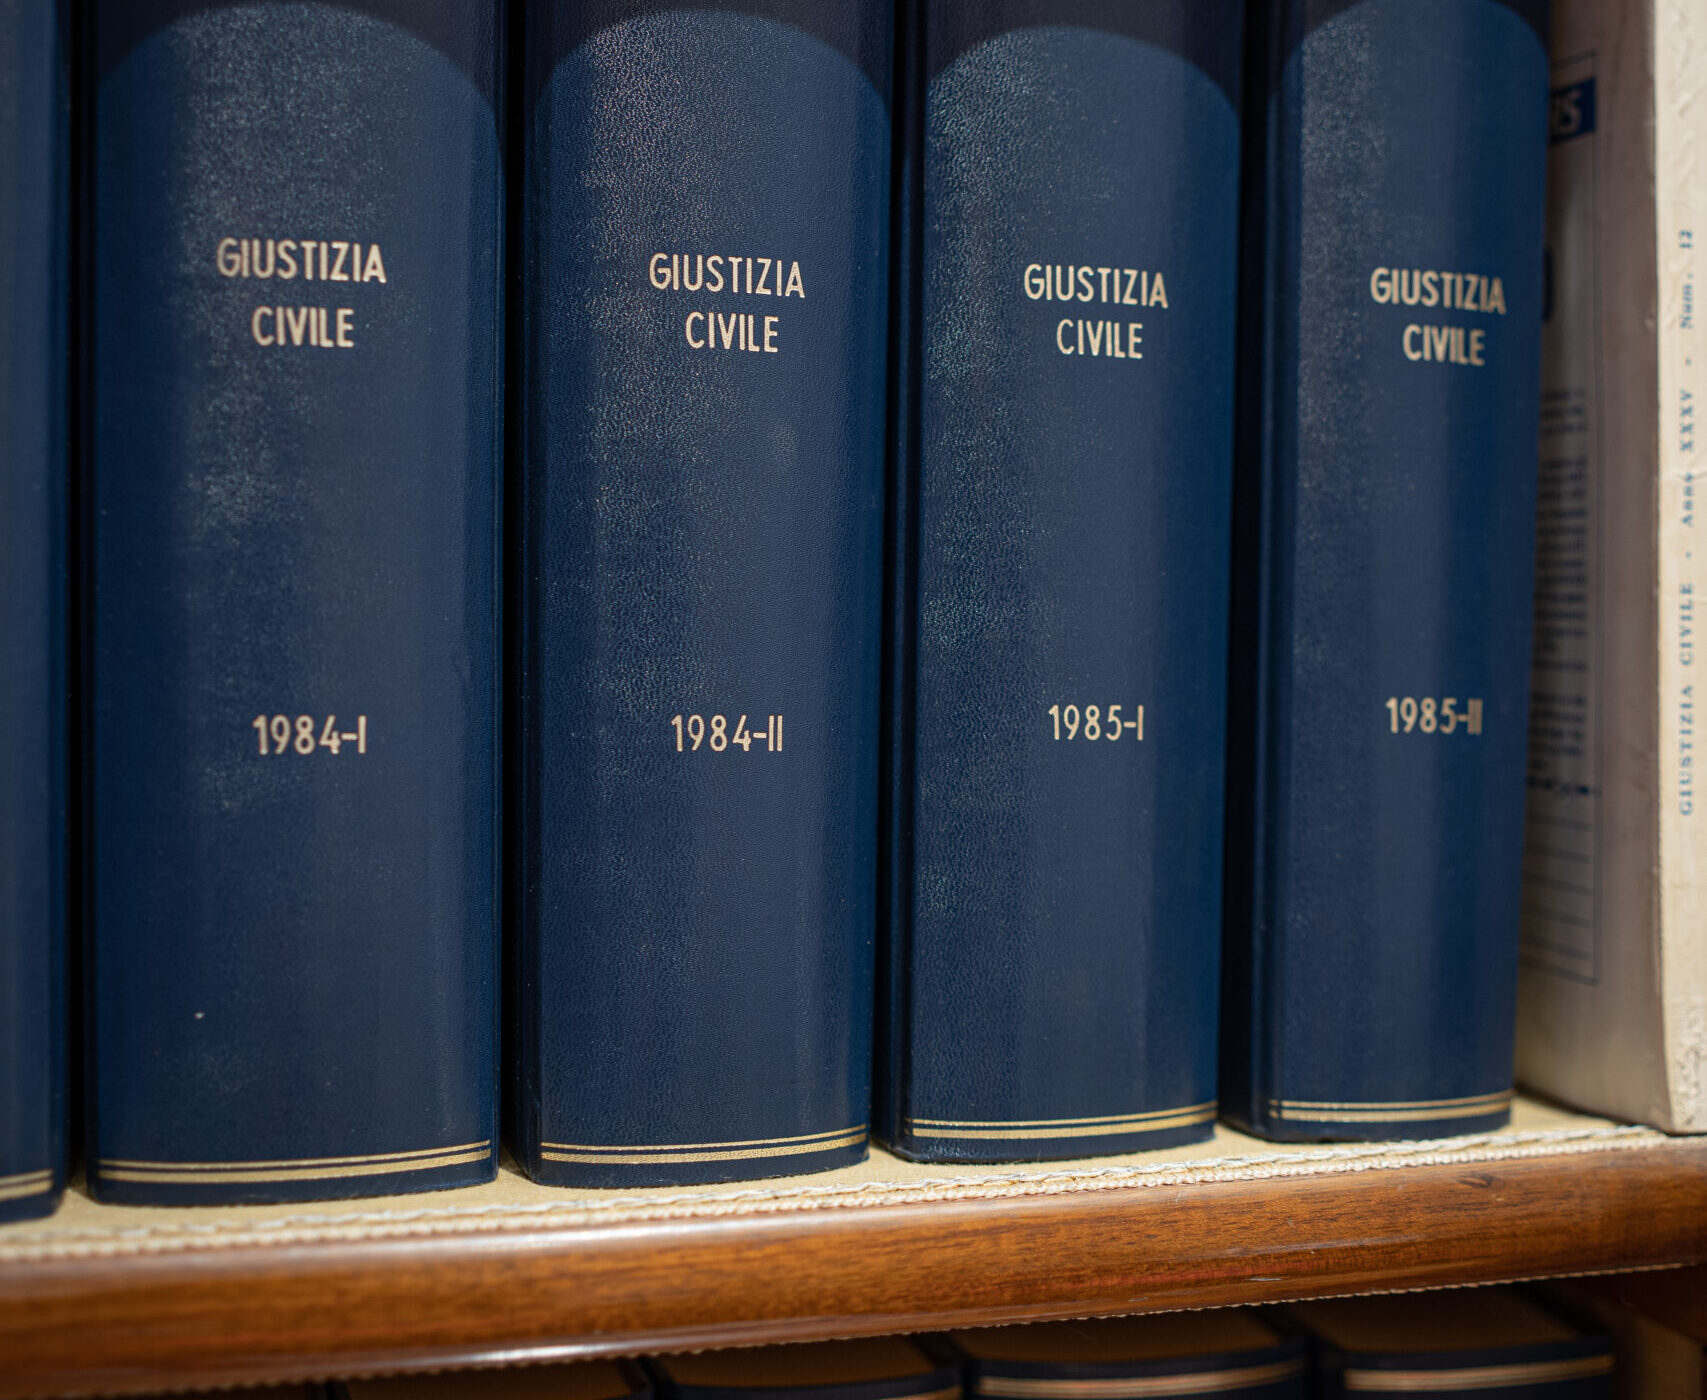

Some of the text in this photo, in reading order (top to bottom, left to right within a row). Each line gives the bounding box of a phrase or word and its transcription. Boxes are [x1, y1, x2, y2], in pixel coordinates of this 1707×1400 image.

[217, 237, 387, 285] GIUSTIZIA
[649, 252, 806, 299] GIUSTIZIA
[1024, 263, 1170, 310] GIUSTIZIA
[1370, 267, 1507, 316] GIUSTIZIA
[251, 305, 355, 348] CIVILE
[685, 311, 780, 353] CIVILE
[1056, 318, 1144, 359] CIVILE
[1402, 323, 1485, 366] CIVILE
[1679, 229, 1693, 816] GIUSTIZIA CIVILE Anno XXXV Num. 12
[253, 714, 368, 755] 1984-I
[670, 713, 783, 753] 1984-II
[1048, 704, 1145, 742] 1985-I
[1385, 697, 1483, 736] 1985-II
